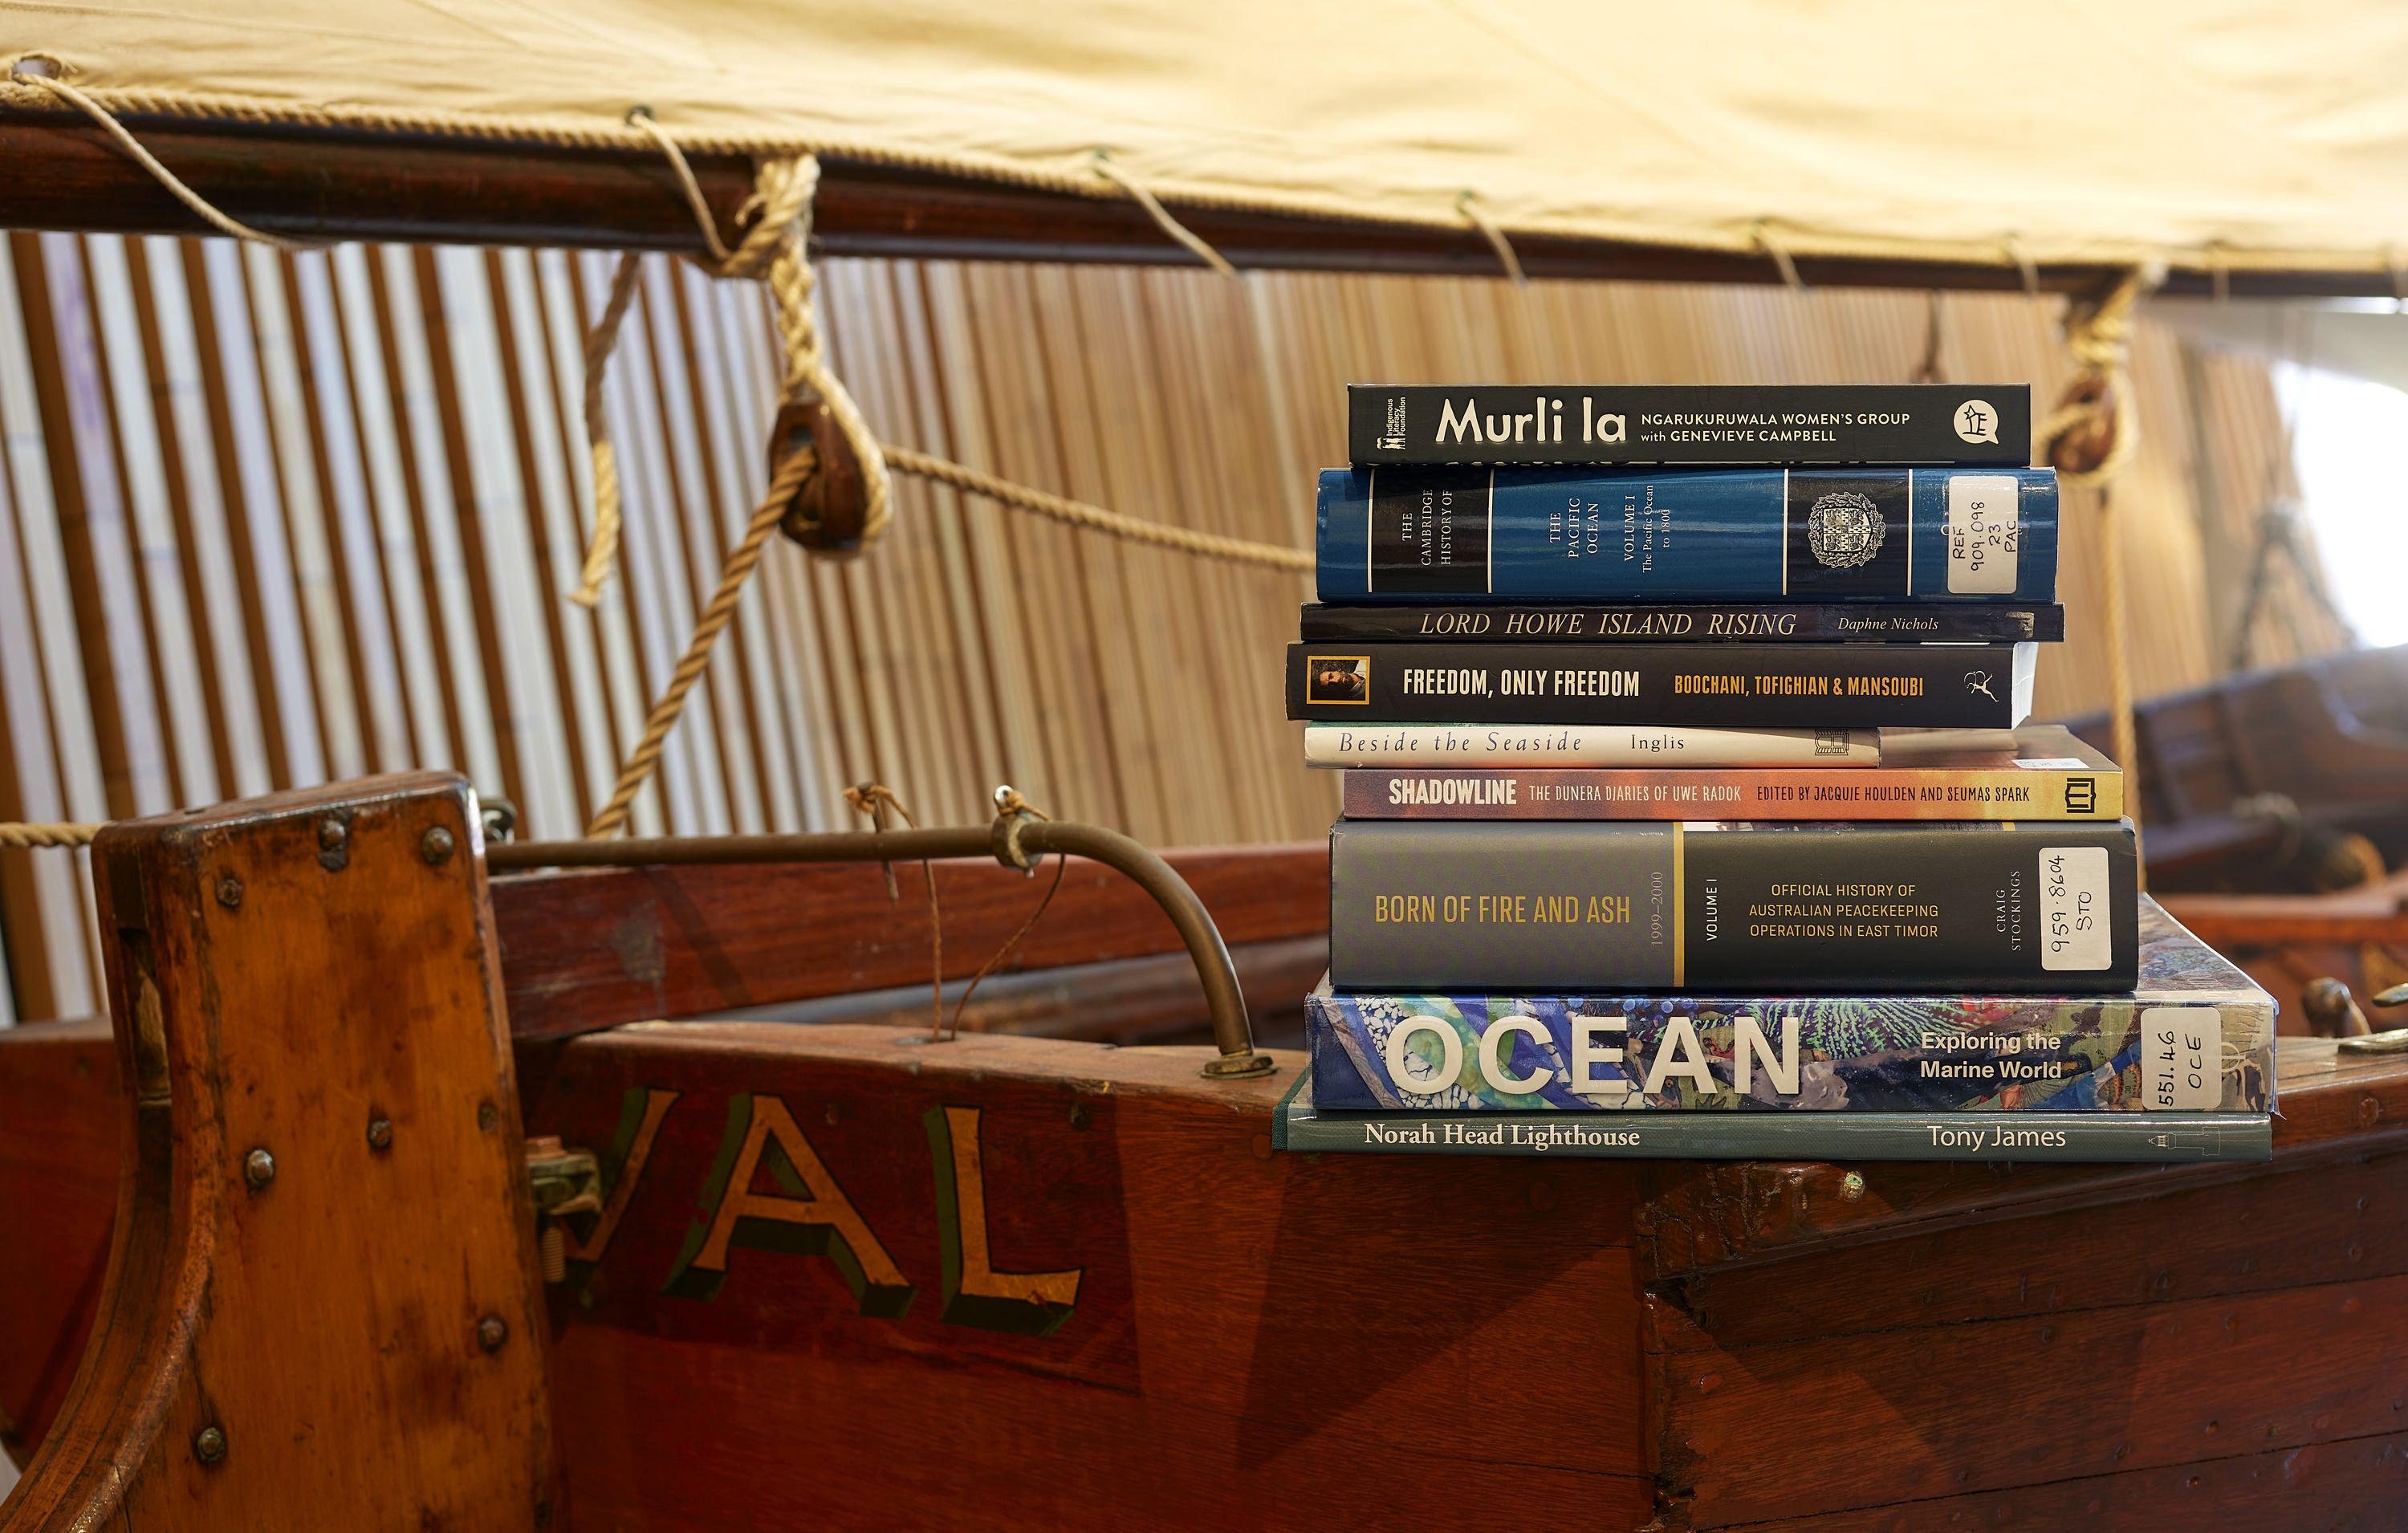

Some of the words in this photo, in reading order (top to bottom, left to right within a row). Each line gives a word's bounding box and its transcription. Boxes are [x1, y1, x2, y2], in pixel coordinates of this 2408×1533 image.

[1386, 399, 1395, 436] Indigenous
[1393, 406, 1401, 436] Literacy
[1435, 396, 1563, 443] Murli
[1582, 396, 1626, 443] la
[1642, 414, 1777, 425] NGARUKURUWALA
[1857, 413, 1910, 424] GROUP
[1641, 431, 1666, 441] with
[1670, 431, 1754, 441] GENEVIEVE
[1759, 430, 1836, 441] CAMPBELL
[1442, 490, 1452, 507] OF
[1643, 485, 1653, 514] Ocean
[1402, 513, 1412, 541] THE
[1422, 490, 1432, 565] CAMBRIDGE
[1550, 512, 1560, 543] THE
[1568, 498, 1580, 558] PACIFIC
[1587, 502, 1599, 554] OCEAN
[1625, 504, 1636, 561] VOLUME
[1643, 518, 1653, 550] Pacific
[1662, 508, 1670, 533] 1800
[1441, 508, 1452, 565] HISTORY
[1663, 538, 1670, 547] to
[1953, 527, 1966, 559] REF
[1971, 502, 1985, 571] 909.098
[1988, 525, 2000, 546] 23
[2004, 521, 2016, 552] PAC
[1642, 554, 1652, 573] The
[1419, 613, 1490, 633] LORD
[1504, 613, 1584, 634] HOWE
[1597, 613, 1692, 634] ISLAND
[1706, 614, 1796, 635] RISING
[1838, 618, 1886, 633] Daphne
[1890, 618, 1938, 629] Nichols
[1404, 669, 1493, 698] FREEDOM,
[1501, 669, 1548, 695] ONLY
[1555, 671, 1639, 696] FREEDOM
[1675, 675, 1749, 697] BOOCHANI,
[1755, 676, 1828, 694] TOFIGHIAN
[1833, 678, 1842, 695] &
[1849, 677, 1922, 696] MANSOUBI
[1339, 731, 1418, 752] Beside
[1434, 732, 1470, 752] the
[1486, 731, 1581, 752] Seaside
[1631, 734, 1685, 753] Inglis
[1389, 779, 1516, 804] SHADOWLINE
[1529, 786, 1550, 800] THE
[1556, 786, 1601, 800] DUNERA
[1606, 786, 1649, 801] DIARIES
[1655, 786, 1668, 801] OF
[1674, 786, 1698, 801] UWE
[1703, 786, 1741, 801] RADOK
[1758, 787, 1793, 800] EDITED
[1799, 787, 1809, 800] BY
[1814, 787, 1860, 801] JACQUIE
[1865, 787, 1915, 801] HOULDEN
[1921, 787, 1942, 801] AND
[1948, 787, 1990, 801] SEUMAS
[1995, 787, 2029, 802] SPARK
[1772, 884, 1832, 896] OFFICIAL
[1837, 885, 1893, 896] HISTORY
[1898, 885, 1915, 896] OF
[1377, 896, 1434, 921] BORN
[1444, 896, 1470, 922] OF
[1480, 897, 1525, 922] FIRE
[1534, 897, 1578, 922] AND
[1587, 897, 1629, 922] ASH
[1706, 887, 1717, 941] VOLUME
[1749, 905, 1831, 916] AUSTRALIAN
[1837, 905, 1938, 917] PEACEKEEPING
[1996, 890, 2006, 932] CRAIG
[2011, 872, 2020, 950] STOCKINGS
[2076, 892, 2092, 930] STO
[1751, 925, 1834, 936] OPERATIONS
[1840, 925, 1852, 937] IN
[1858, 925, 1889, 937] EAST
[1894, 925, 1937, 937] TIMOR
[1385, 1015, 1800, 1095] OCEAN
[1922, 1032, 2020, 1052] Exploring
[2027, 1032, 2060, 1049] the
[1921, 1061, 1994, 1078] Marine
[1999, 1060, 2061, 1078] World
[2158, 1031, 2176, 1107] 551.46
[2185, 1034, 2202, 1088] OCE
[1365, 1124, 1436, 1145] Norah
[1443, 1124, 1504, 1145] Head
[1511, 1125, 1641, 1151] Lighthouse
[1926, 1126, 1985, 1152] Tony
[1991, 1126, 2066, 1147] James
